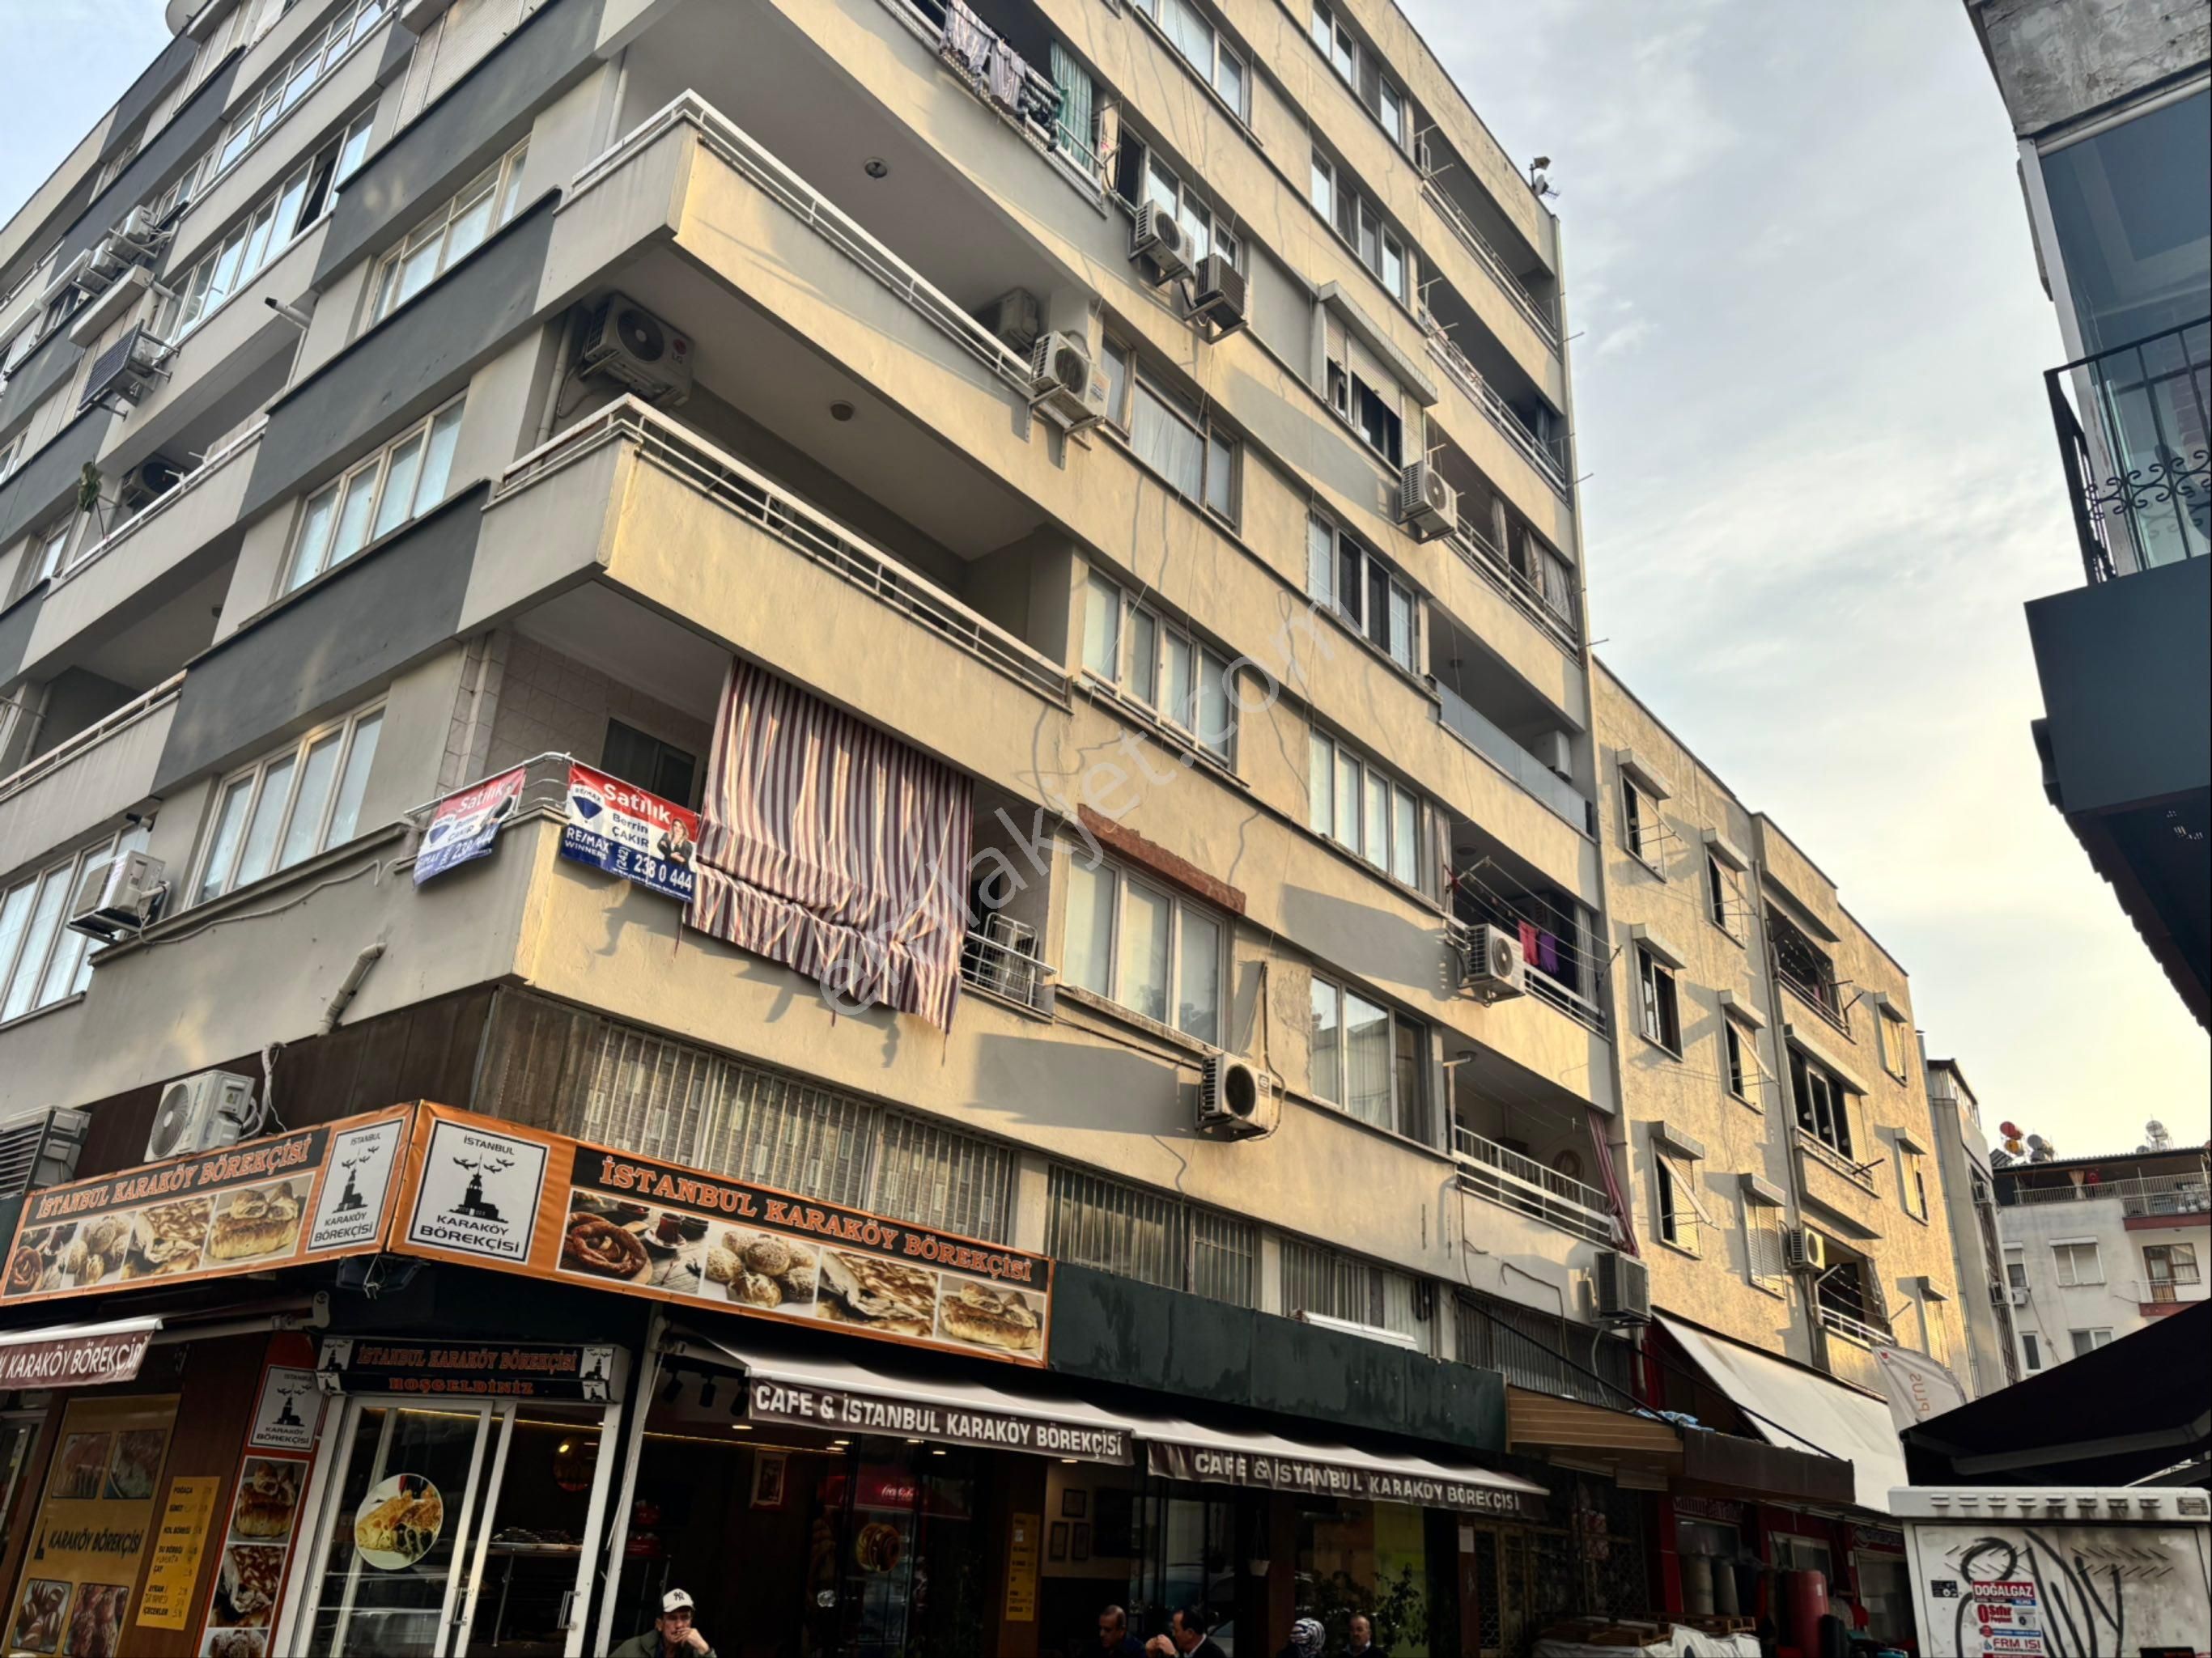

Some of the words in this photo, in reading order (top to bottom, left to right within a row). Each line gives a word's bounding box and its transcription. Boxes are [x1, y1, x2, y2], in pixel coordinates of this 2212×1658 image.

[456, 781, 504, 813] Satılık
[575, 787, 601, 802] RE/MAX
[604, 783, 671, 825] Satılık
[613, 813, 648, 834] Berrin
[567, 827, 609, 854] RE/MAX
[612, 827, 649, 847] ÇAKIR
[564, 840, 607, 860] WINNERS
[616, 846, 631, 871] (242)
[633, 854, 657, 879] 238
[659, 864, 667, 883] 0
[669, 868, 692, 892] 444
[350, 1133, 380, 1146] İSTANBUL
[464, 1134, 516, 1156] İSTANBUL
[36, 1191, 110, 1219] İSTANBUL
[110, 1164, 198, 1204] KARAKÖY
[198, 1133, 313, 1187] BÖREKÇİSİ
[325, 1211, 367, 1227] KARAKÖY
[436, 1215, 509, 1236] KARAKÖY
[600, 1156, 758, 1217] İSTANBUL
[763, 1198, 900, 1251] KARAKÖY
[903, 1232, 1033, 1283] BÖREKÇİSİ
[314, 1221, 374, 1243] BÖREKÇİSİ
[419, 1224, 520, 1253] BÖREKÇİSİ
[5, 1345, 73, 1379] KARAKÖY
[357, 1344, 427, 1366] İSTANBUL
[427, 1347, 498, 1371] KARAKÖY
[499, 1348, 578, 1375] BÖREKÇİSİ
[388, 1377, 534, 1394] HOŞGELDİNİZ
[756, 1385, 813, 1417] CAFE
[820, 1395, 834, 1420] &
[842, 1393, 940, 1434] İSTANBUL
[946, 1415, 1030, 1447] KARAKÖY
[1036, 1422, 1123, 1460] BÖREKÇİSİ
[1195, 1452, 1246, 1478] CAFE
[1254, 1461, 1269, 1480] &
[1273, 1460, 1363, 1492] İSTANBUL
[1447, 1484, 1520, 1512] BÖREKÇİSİ
[49, 1527, 95, 1551] KARAKÖY
[91, 1527, 144, 1559] BÖREKÇİSİ
[1975, 1583, 2033, 1597] DOĞALGAZ
[1993, 1638, 2020, 1647] FRM
